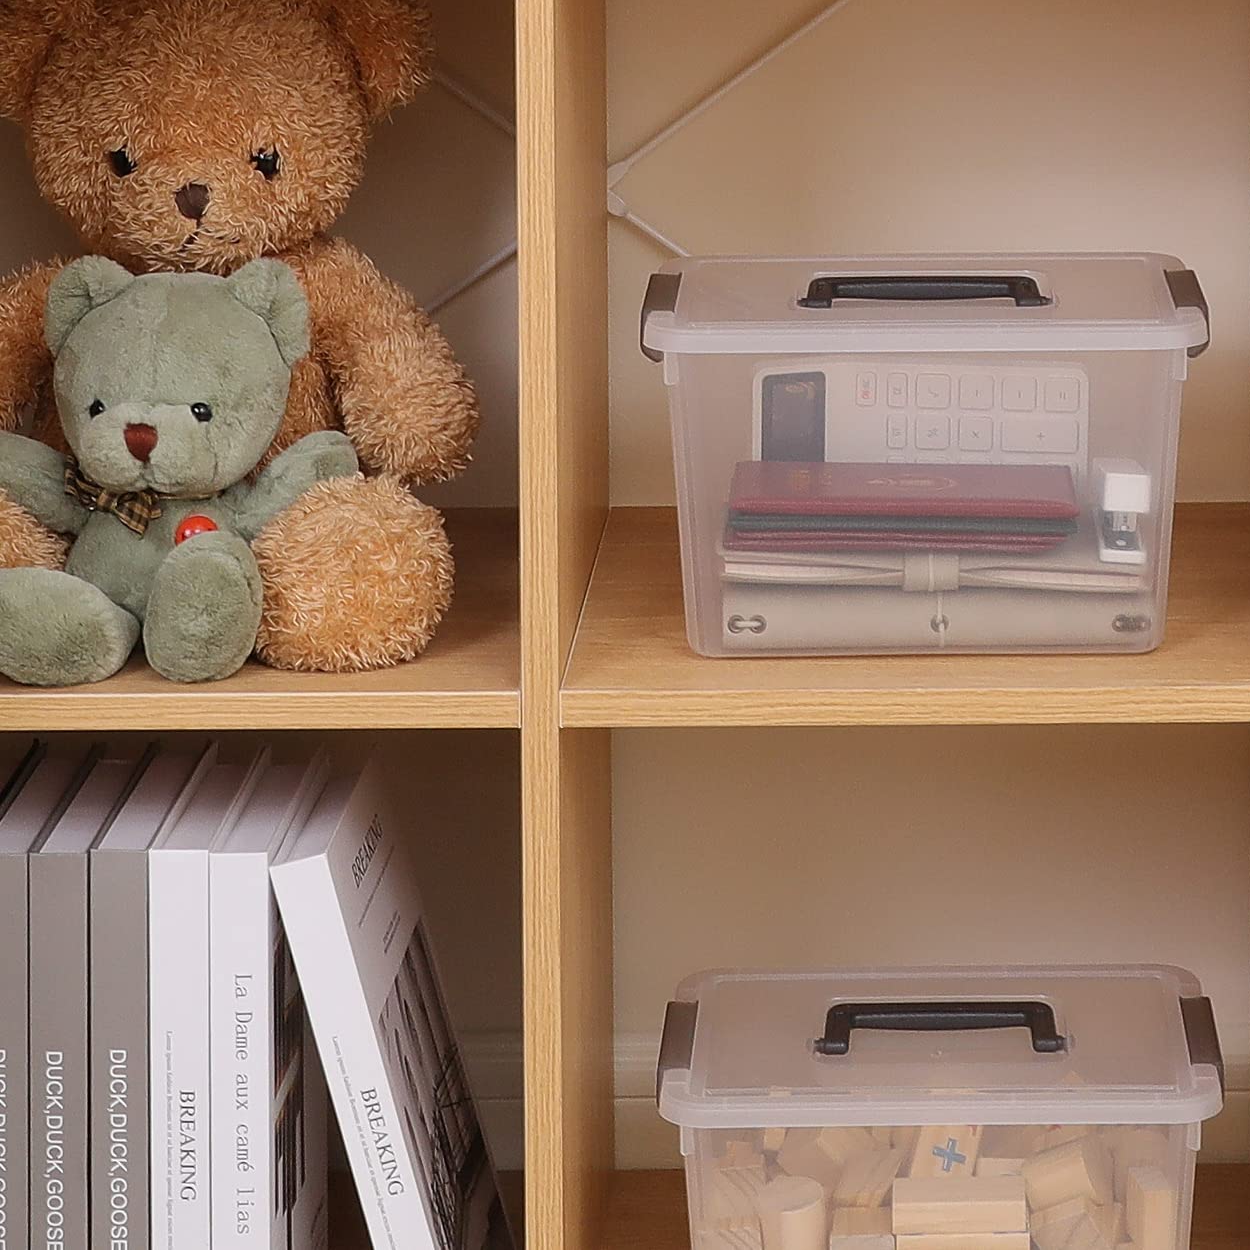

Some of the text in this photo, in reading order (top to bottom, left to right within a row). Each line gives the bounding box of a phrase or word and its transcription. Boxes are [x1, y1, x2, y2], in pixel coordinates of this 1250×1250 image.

[351, 814, 383, 888] BREAKING
[178, 1090, 197, 1201] BREAKING
[235, 975, 255, 1235] La Dame aux camé lias
[360, 1087, 404, 1196] BREAKING
